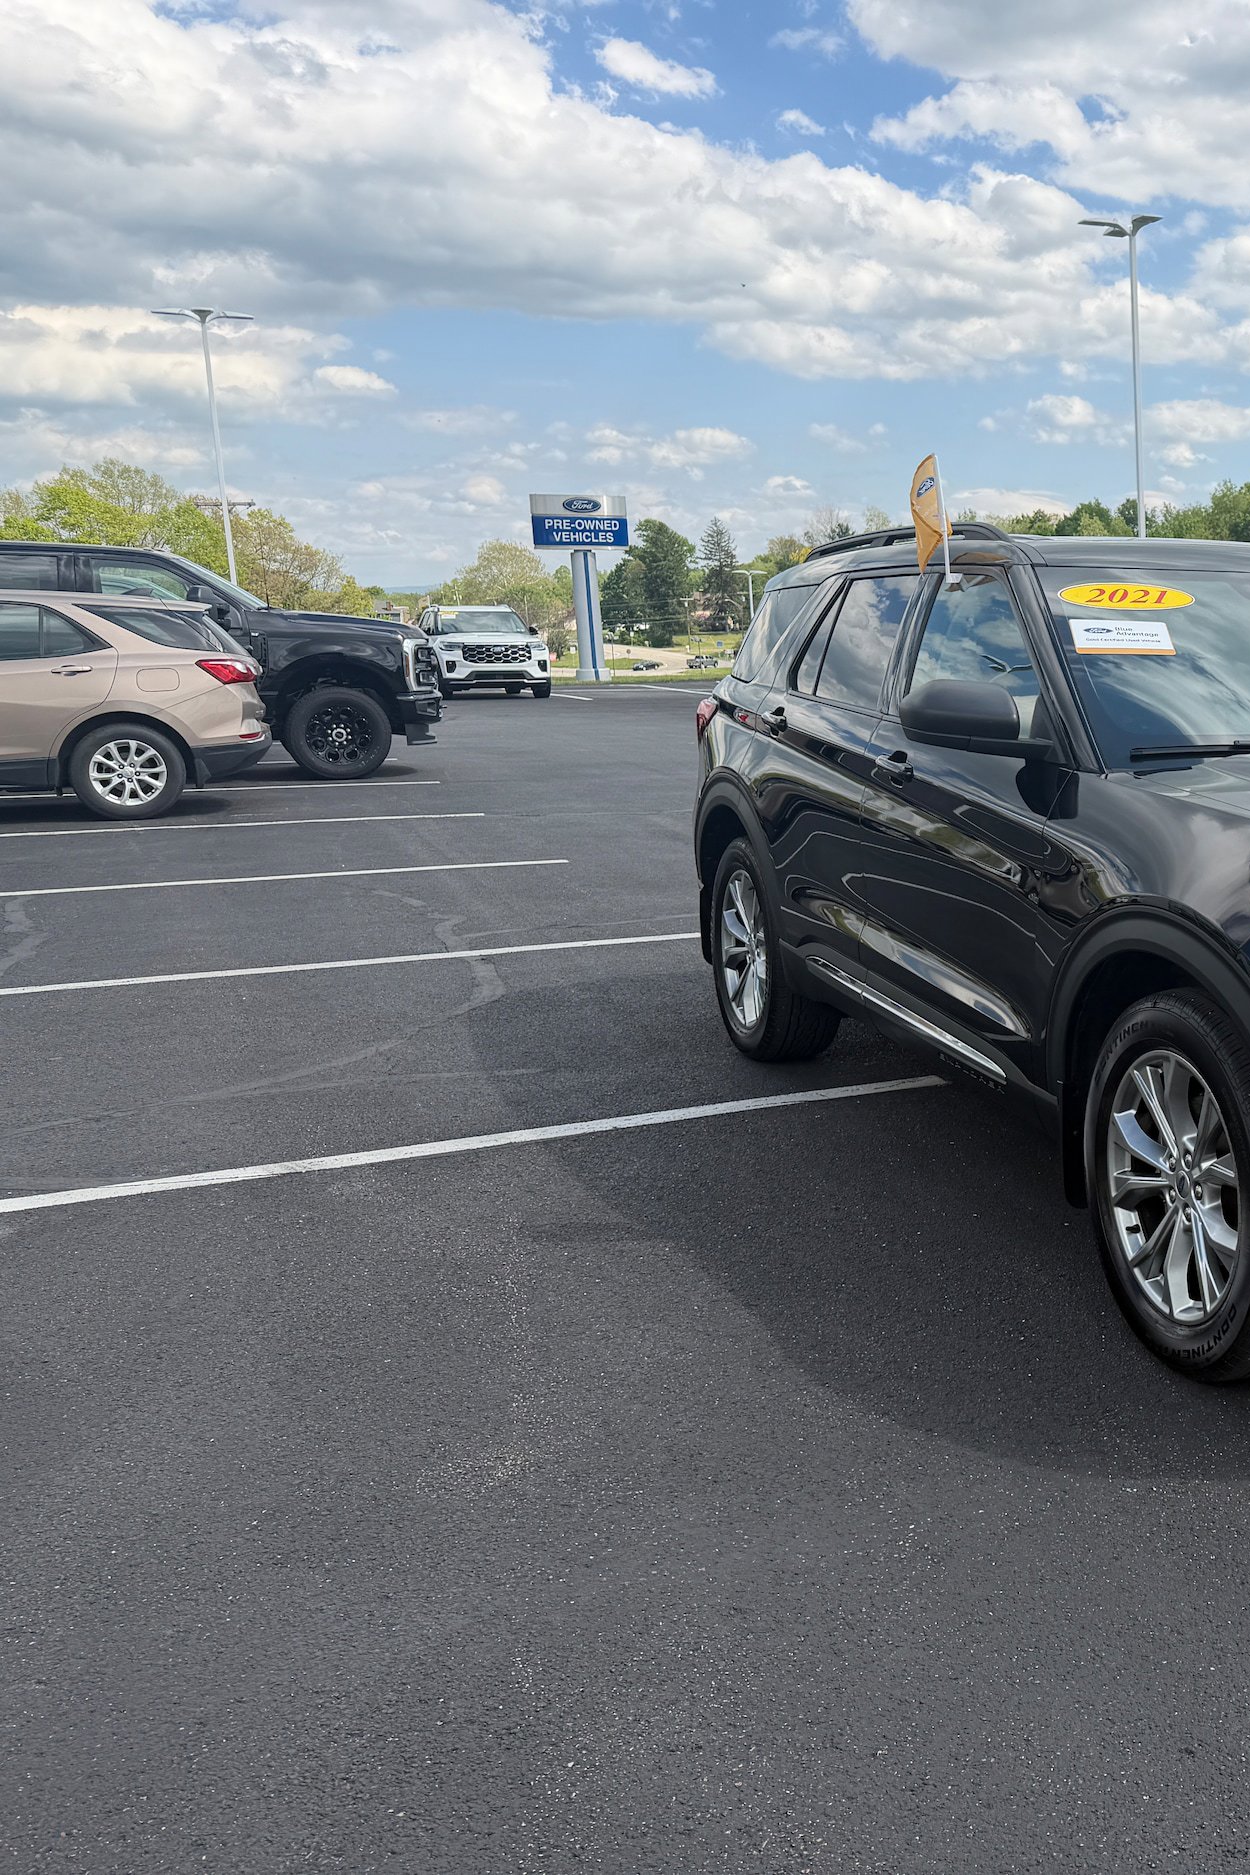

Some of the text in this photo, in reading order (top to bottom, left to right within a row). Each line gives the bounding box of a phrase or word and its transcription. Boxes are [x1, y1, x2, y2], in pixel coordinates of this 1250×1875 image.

[544, 518, 620, 531] PRE-OWNED
[553, 531, 614, 543] VEHICLES
[1084, 588, 1168, 604] 2021
